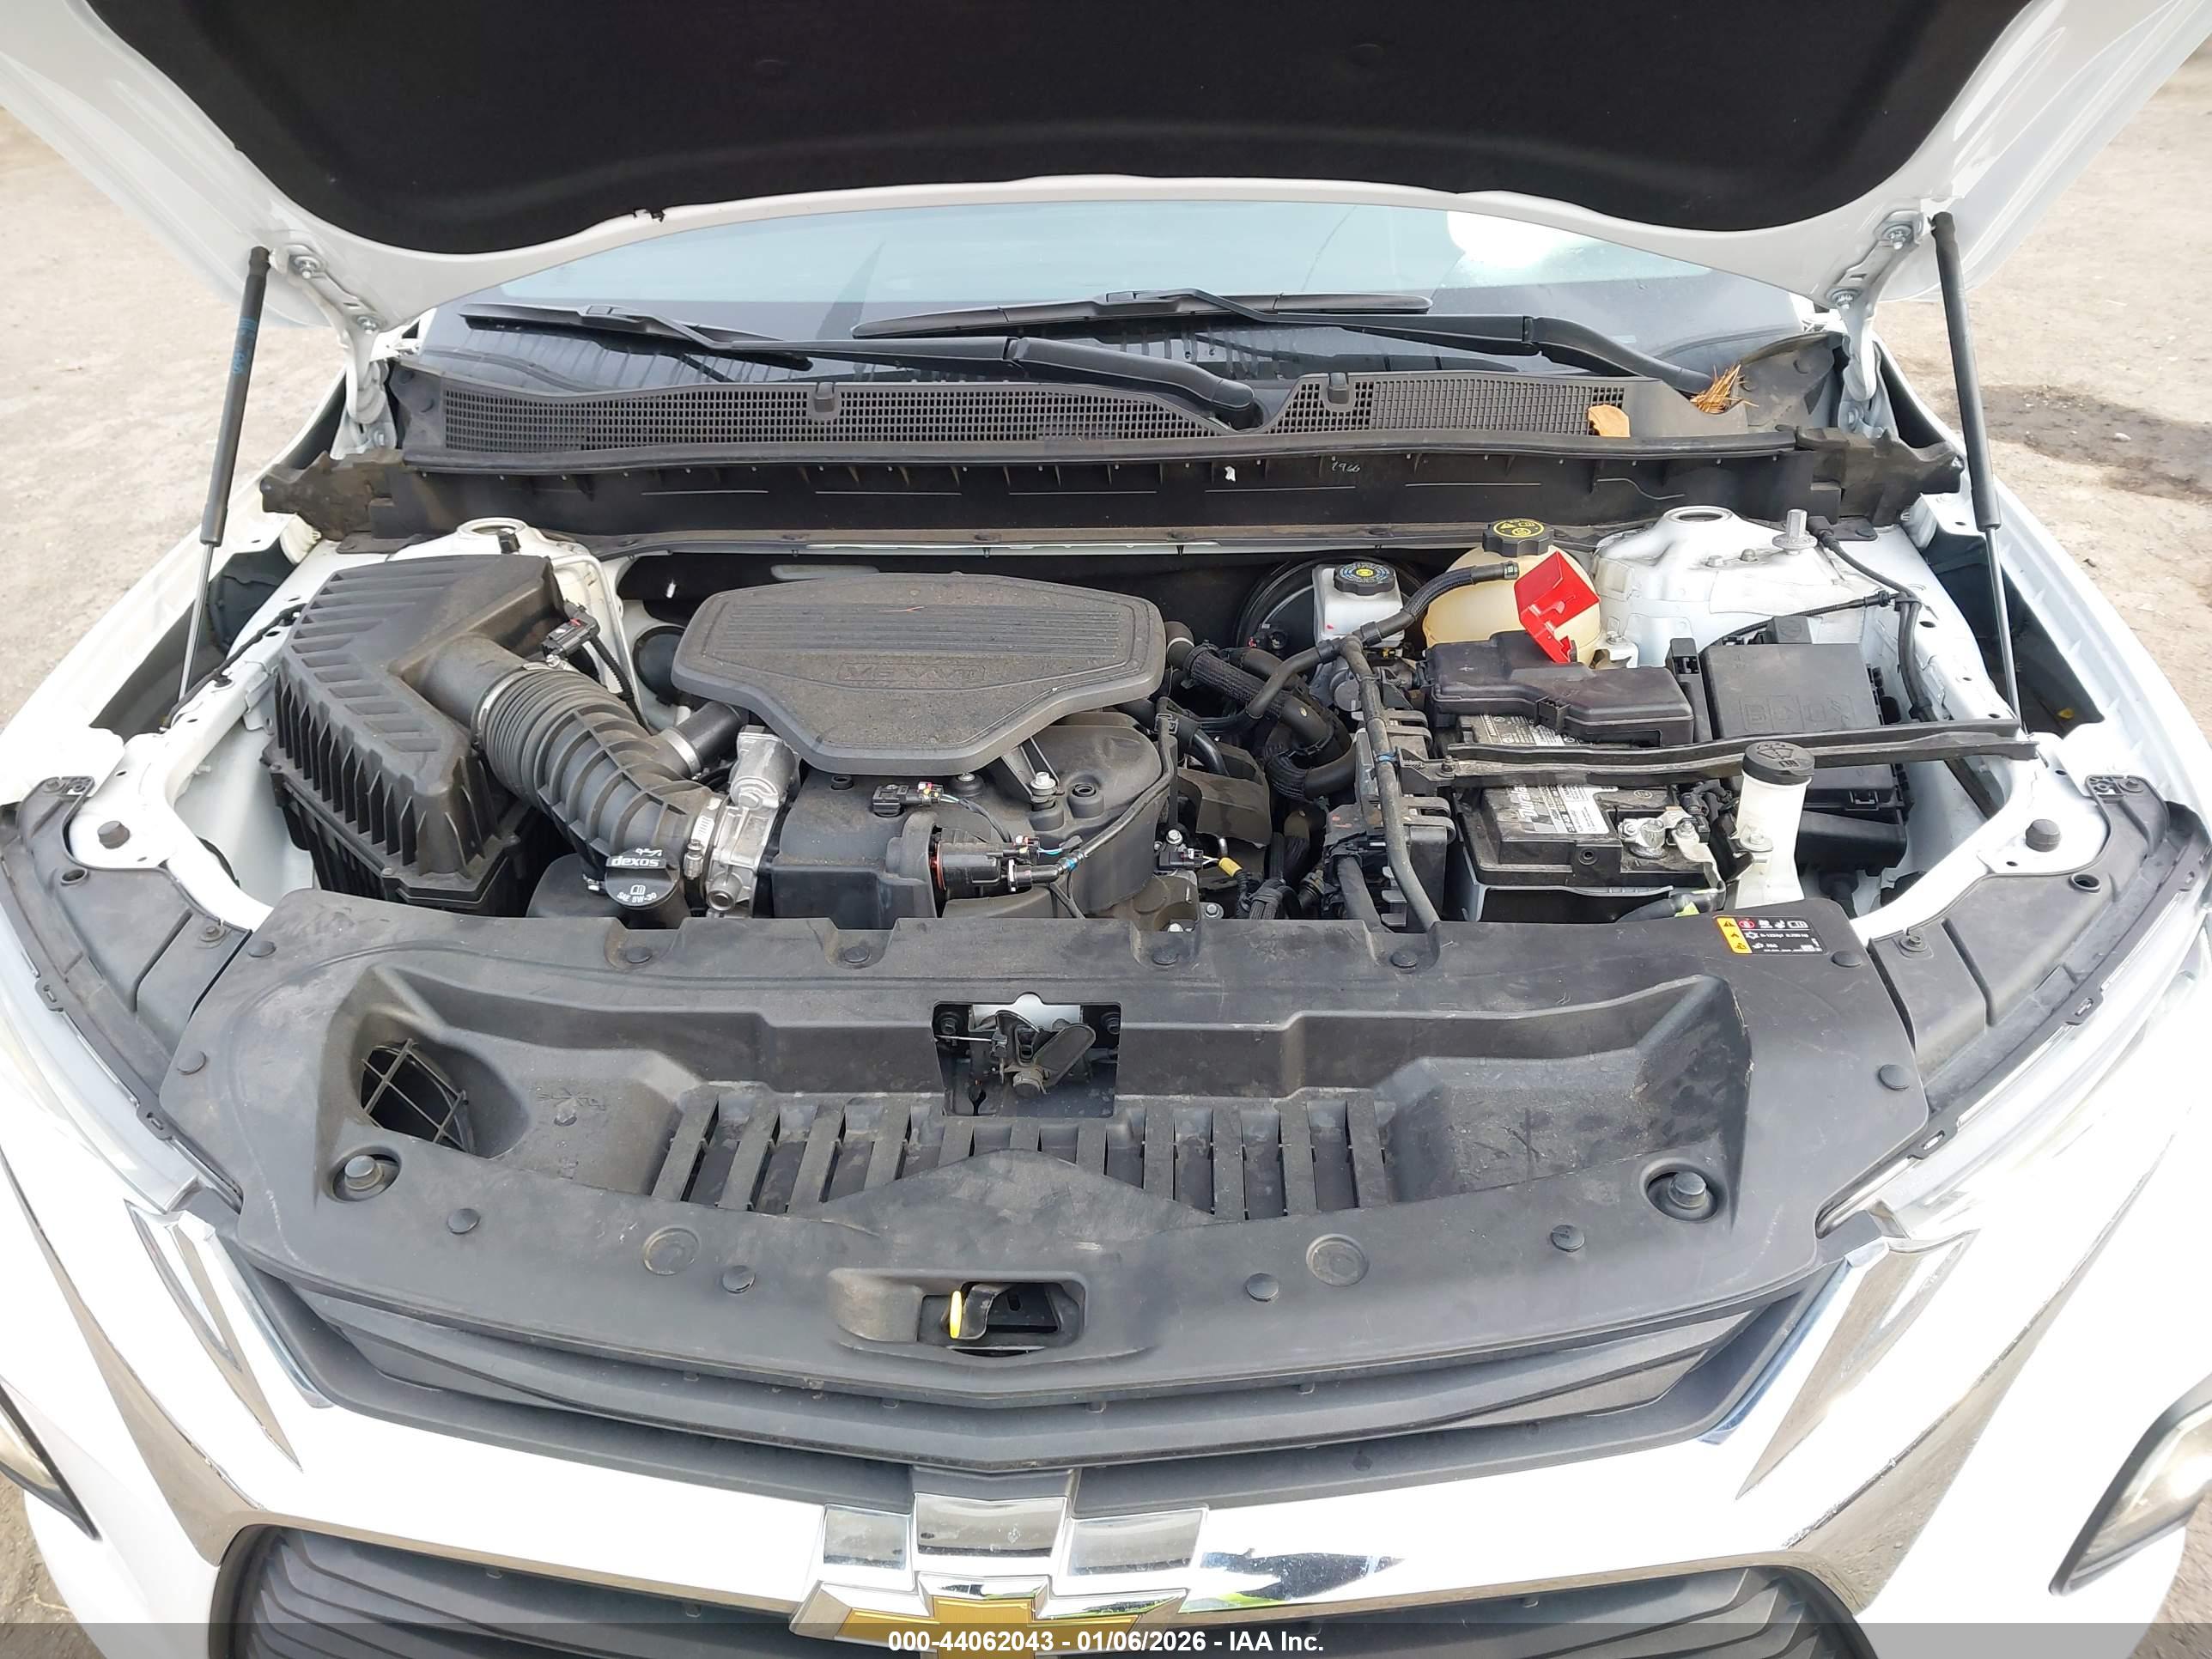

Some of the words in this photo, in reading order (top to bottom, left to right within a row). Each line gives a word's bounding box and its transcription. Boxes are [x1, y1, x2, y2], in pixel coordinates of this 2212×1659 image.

[611, 855, 659, 866] dexos
[617, 891, 631, 902] SAE
[631, 891, 658, 903] 5W-30
